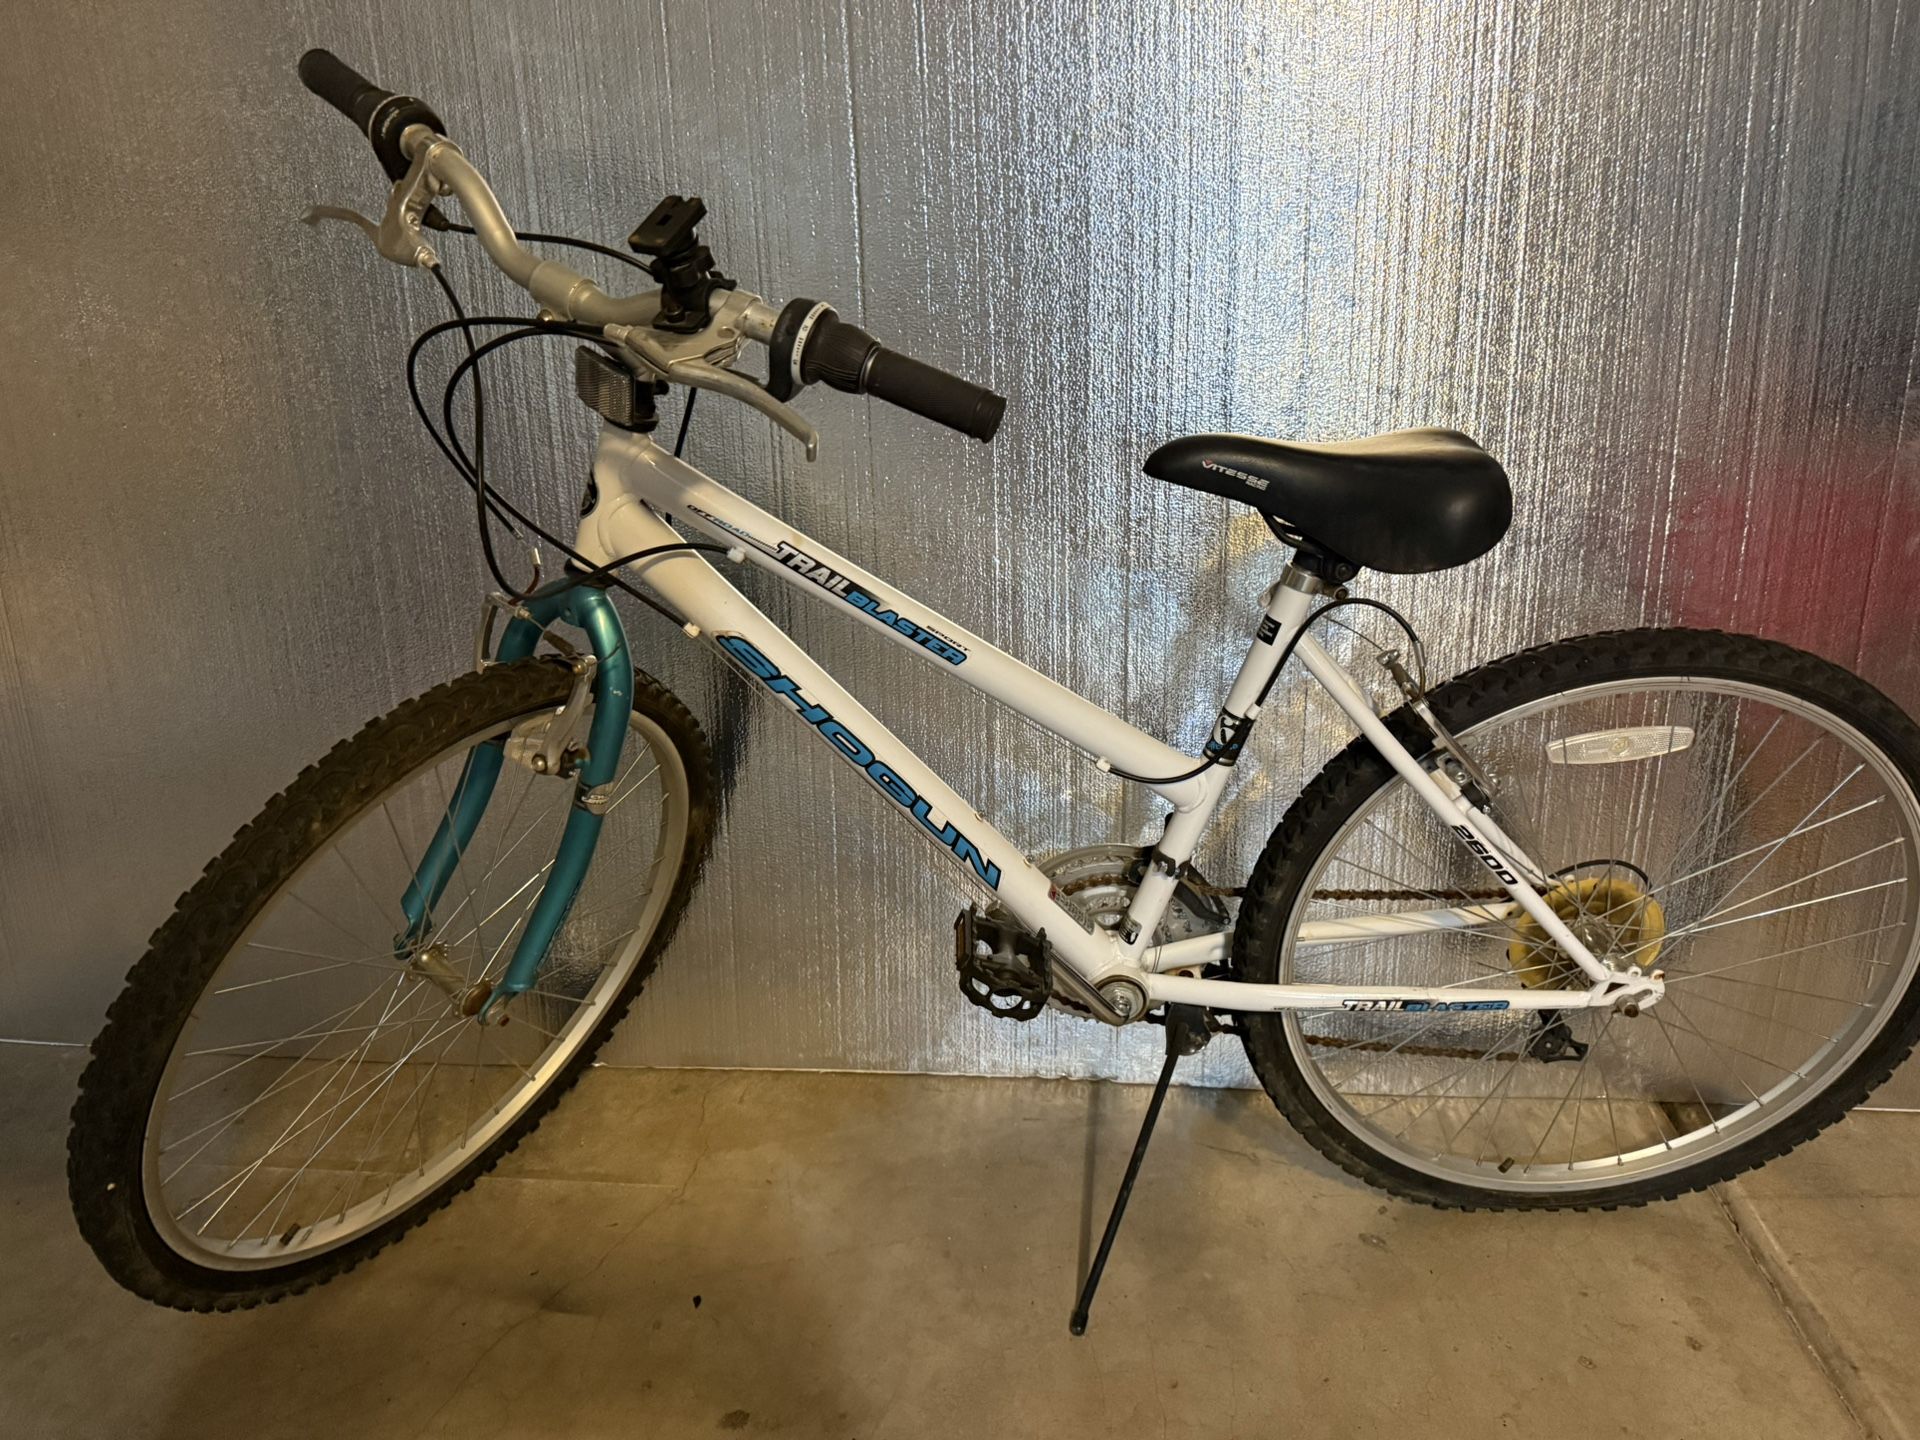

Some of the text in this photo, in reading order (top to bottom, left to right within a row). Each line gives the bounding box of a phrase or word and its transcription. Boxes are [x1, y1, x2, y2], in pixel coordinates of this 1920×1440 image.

[1202, 459, 1270, 487] VITESSE
[926, 625, 971, 651] SPORT
[715, 635, 1002, 892] SHOGUN
[1451, 825, 1518, 886] 2600
